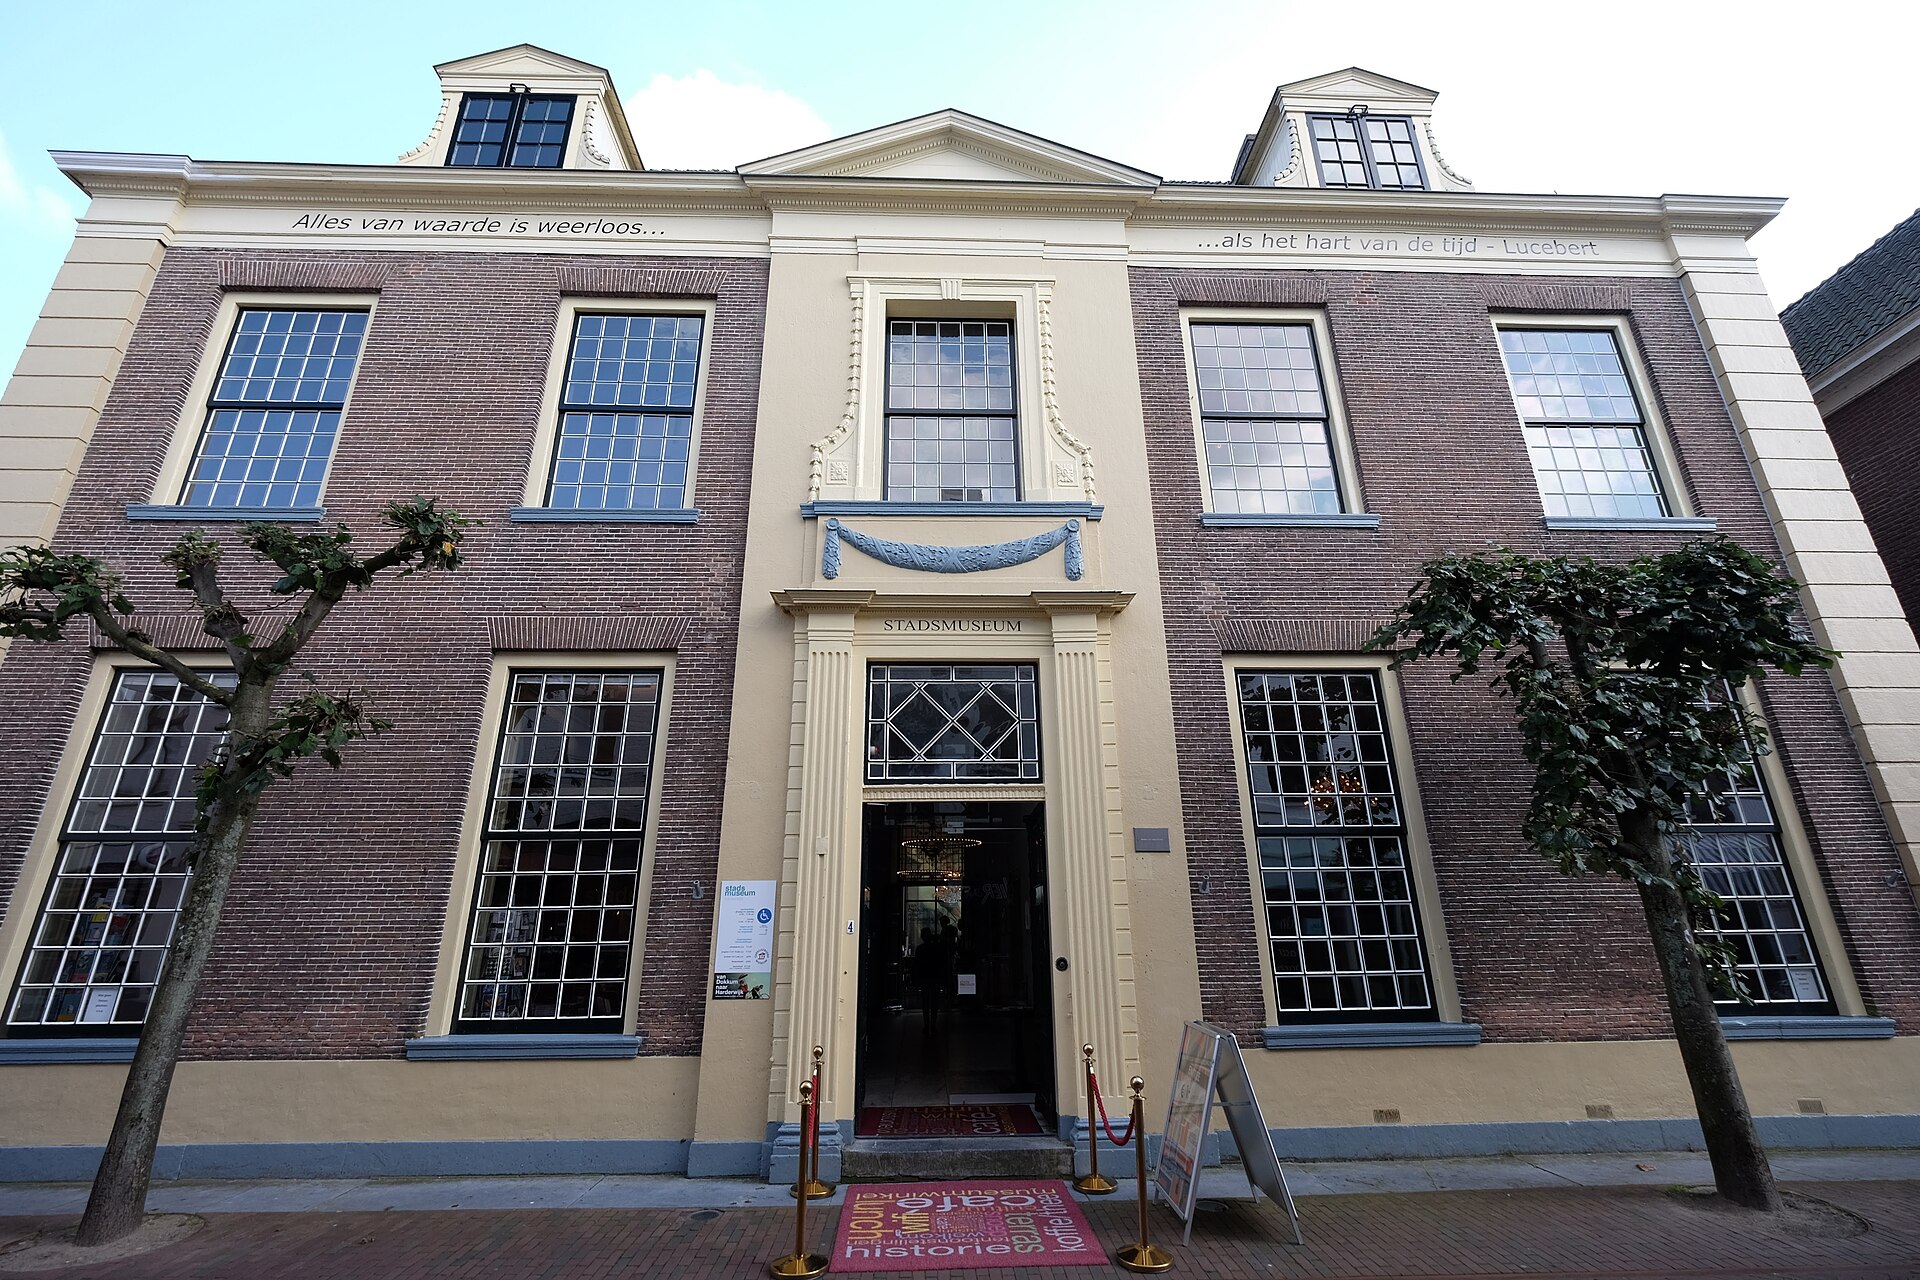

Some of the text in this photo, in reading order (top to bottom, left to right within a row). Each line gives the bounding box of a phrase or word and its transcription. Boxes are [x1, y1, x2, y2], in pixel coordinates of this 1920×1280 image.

[292, 214, 667, 236] Alles van waarde is weerloos...
[1198, 233, 1254, 248] ...als
[1261, 233, 1298, 249] het
[1306, 234, 1351, 250] hart
[1360, 238, 1398, 251] van
[1408, 237, 1434, 252] de
[1442, 237, 1477, 255] tijd
[1503, 239, 1600, 256] Lucebert
[884, 619, 1022, 632] STADSMUSEUM
[725, 884, 746, 892] stads
[847, 921, 853, 932] 4
[856, 1187, 1056, 1200] museumwinkel
[896, 1195, 1036, 1213] café
[848, 1200, 896, 1240] lunch
[1004, 1211, 1045, 1253] terras
[846, 1242, 1011, 1258] historie
